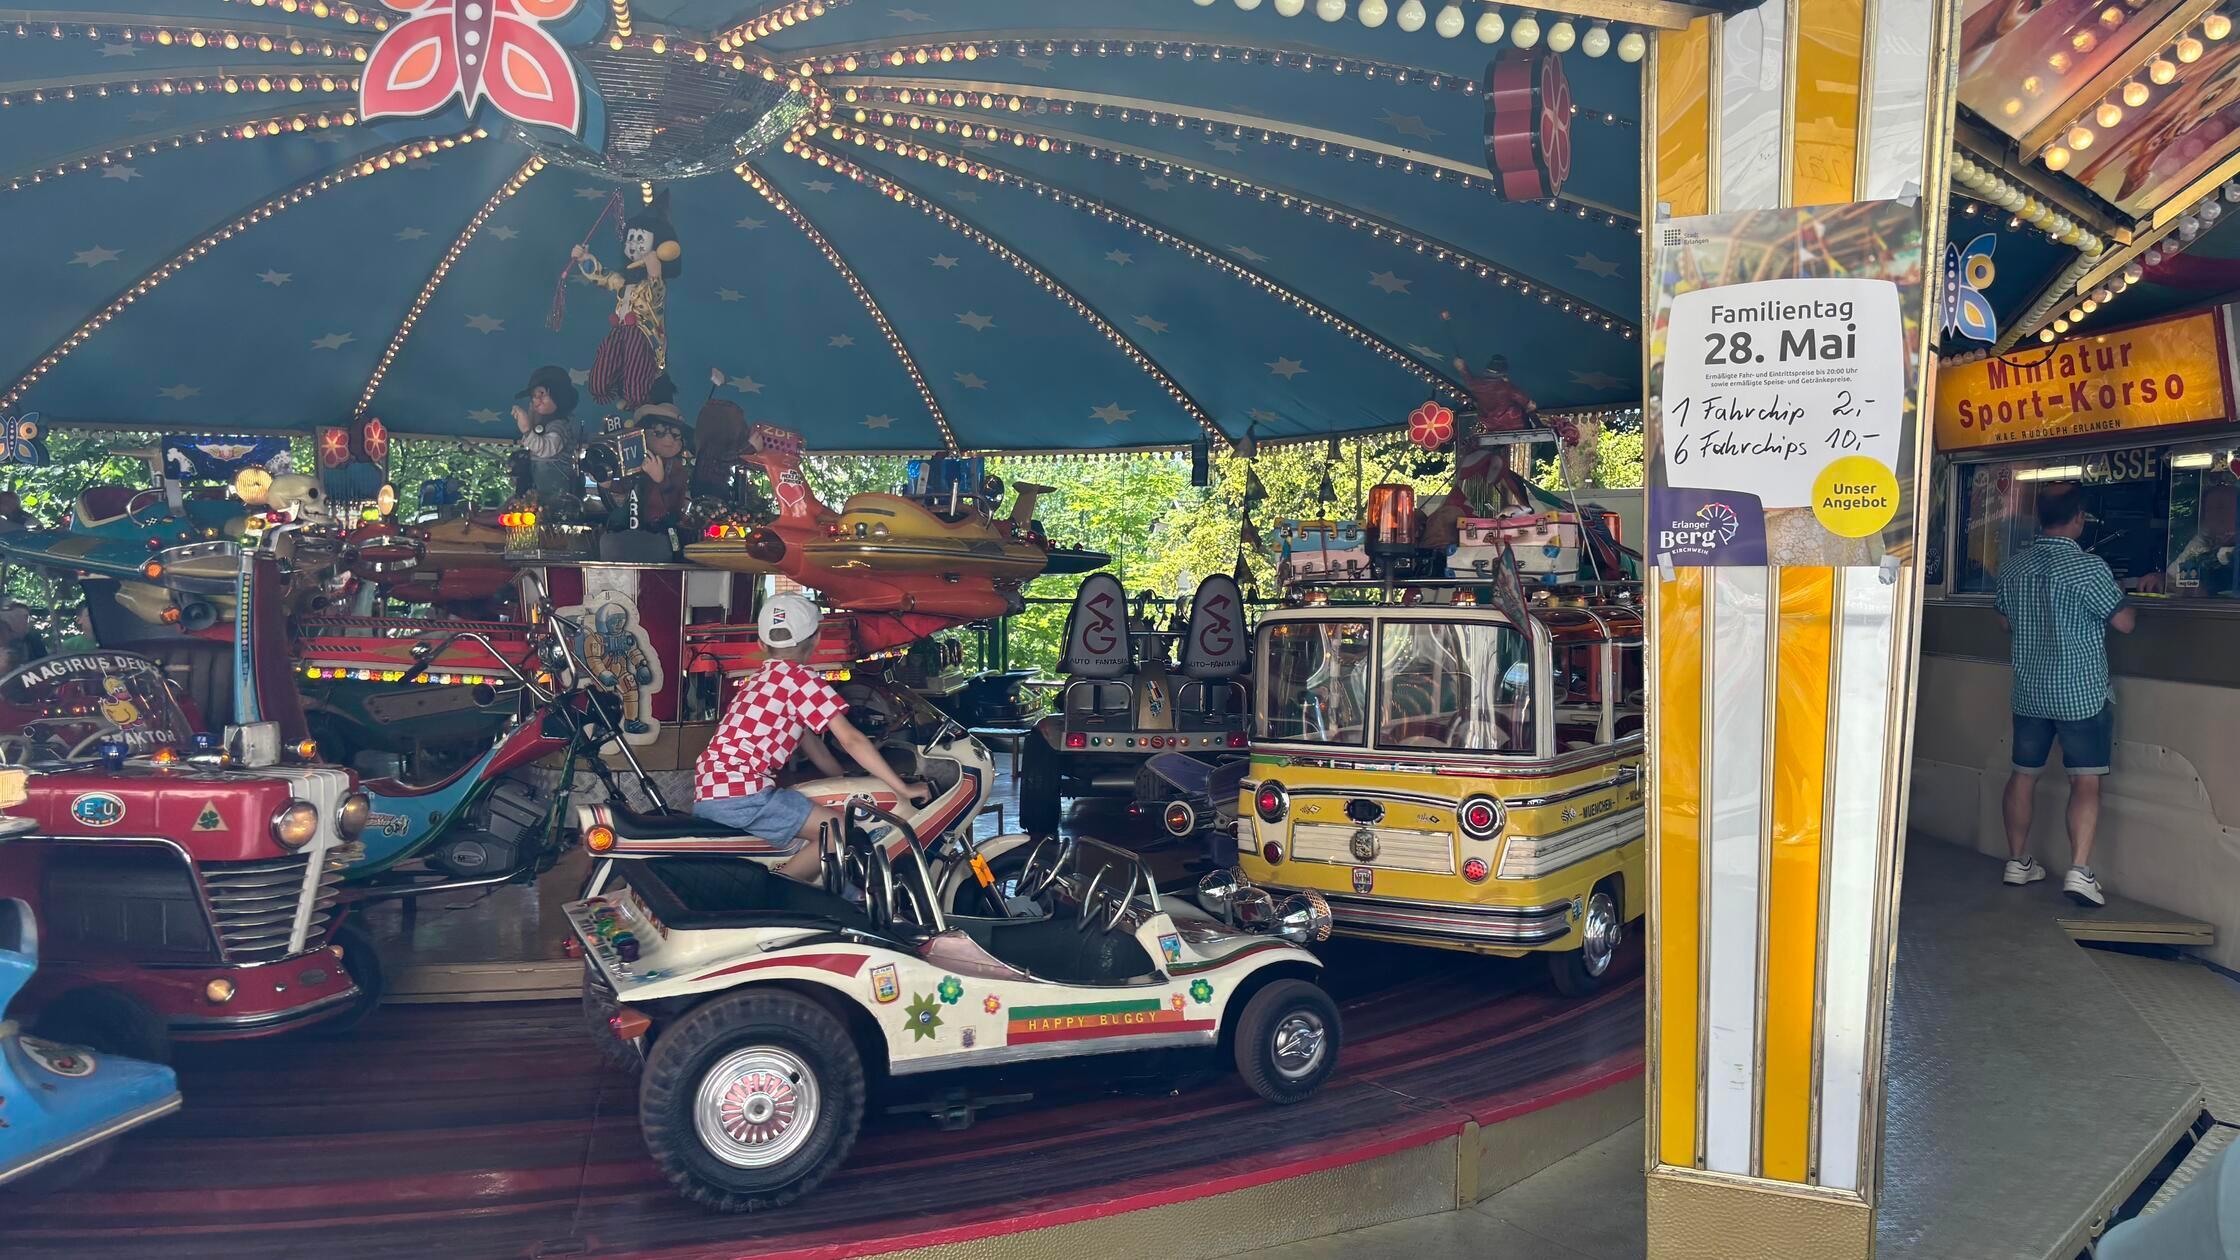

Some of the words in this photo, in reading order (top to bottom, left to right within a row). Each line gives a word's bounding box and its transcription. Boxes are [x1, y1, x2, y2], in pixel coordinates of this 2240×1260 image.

[1710, 300, 1854, 324] Familientag
[1704, 331, 1766, 366] 28.
[1779, 323, 1857, 362] Mai
[1705, 372, 1738, 381] Ermäßigte
[1738, 371, 1755, 379] Fahr-
[1768, 369, 1815, 378] Eintrittspreise
[1815, 368, 1826, 376] bis
[1845, 367, 1858, 375] Uhr
[1987, 342, 2133, 390] Miniatur
[1729, 379, 1763, 388] ermäßigte
[1763, 379, 1787, 387] Speise-
[1800, 376, 1853, 385] Getränkepreise.
[1672, 396, 1690, 428] 1
[1702, 393, 1805, 426] Fahrchip
[1958, 373, 2184, 431] Sport-Korso
[607, 416, 622, 432] BR
[763, 424, 795, 440] ZDF
[2021, 426, 2068, 439] RUDOLPH
[2073, 418, 2121, 433] ERLANGEN
[623, 445, 637, 461] TV
[1673, 434, 1689, 465] 6
[1700, 429, 1808, 461] Fahrchips
[2080, 447, 2156, 483] KASSE
[1833, 482, 1878, 496] Unser
[629, 489, 639, 530] ARD
[1822, 495, 1888, 510] Angebot
[1672, 520, 1710, 530] Erlanger
[1660, 529, 1717, 549] Berg
[21, 656, 110, 689] MAGIRUS
[1028, 1016, 1086, 1031] HAPPY
[1100, 1011, 1157, 1026] BUGGY
